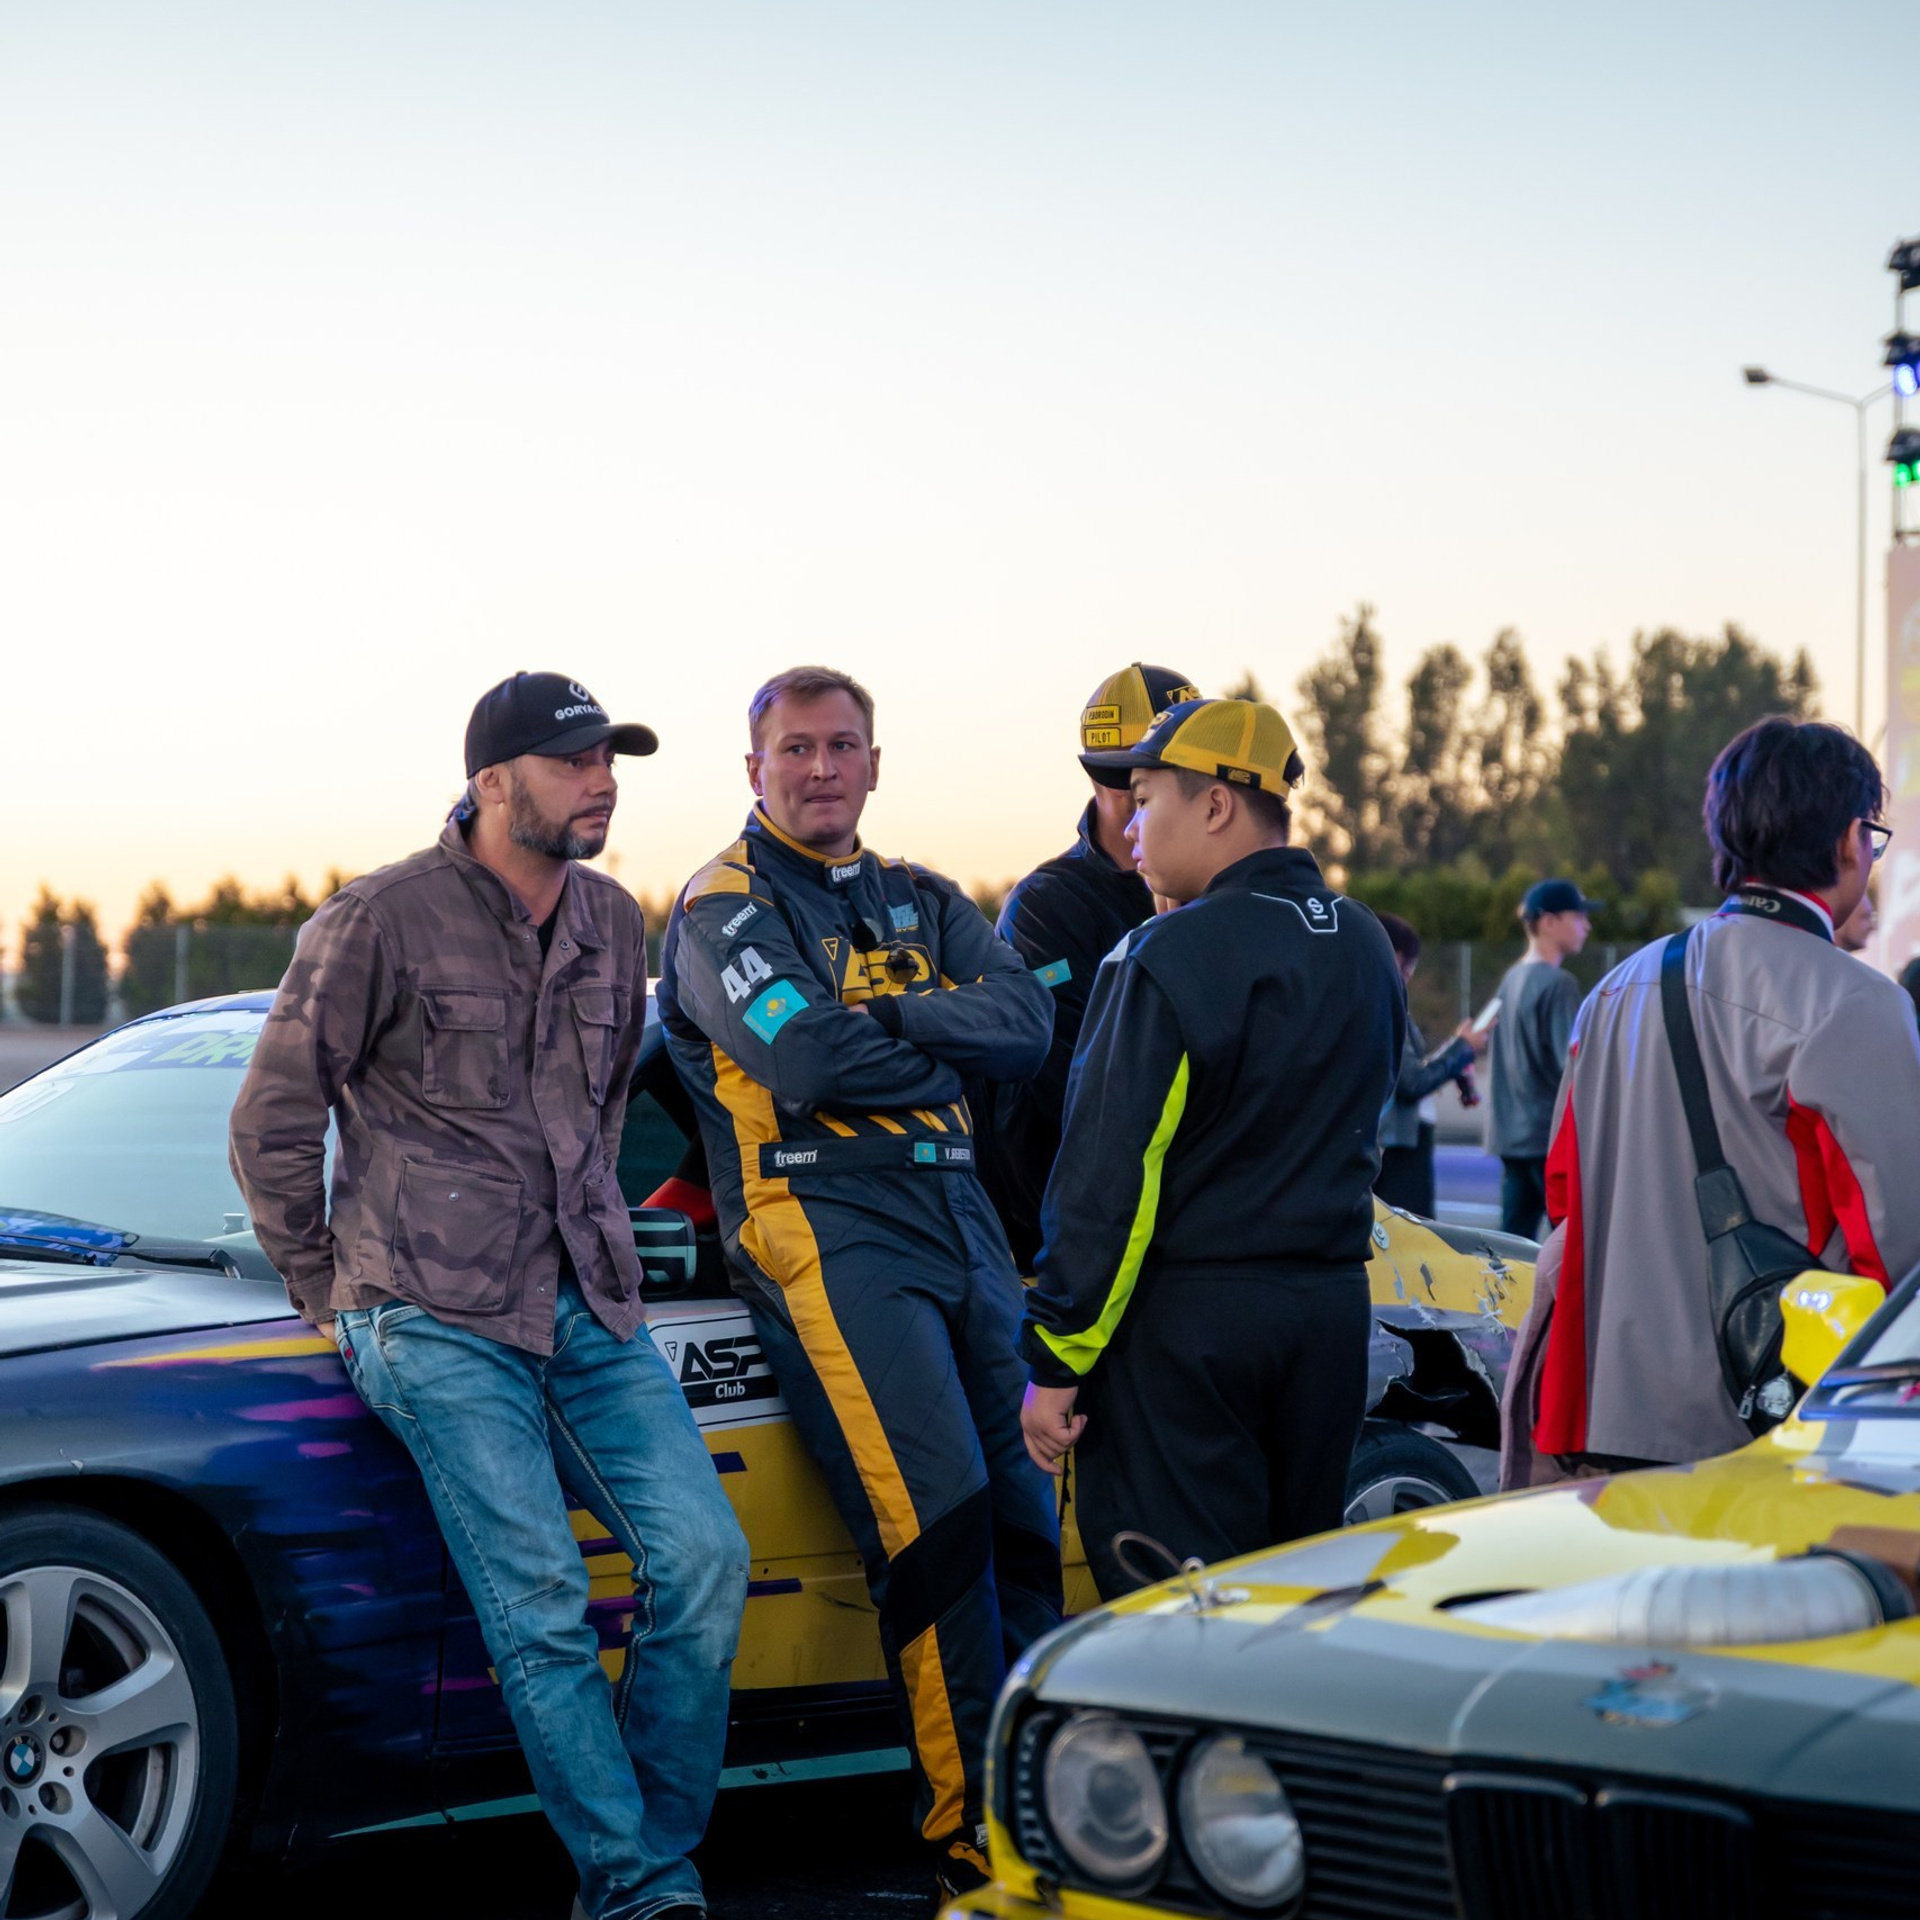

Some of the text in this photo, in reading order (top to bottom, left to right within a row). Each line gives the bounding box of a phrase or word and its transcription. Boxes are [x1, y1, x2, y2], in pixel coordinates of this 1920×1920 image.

[1091, 732, 1111, 743] PILOT
[831, 861, 861, 882] freem
[721, 902, 758, 937] freem
[720, 946, 774, 1004] 44
[774, 1149, 818, 1167] freem
[680, 1334, 769, 1383] ASP
[715, 1381, 746, 1399] Club
